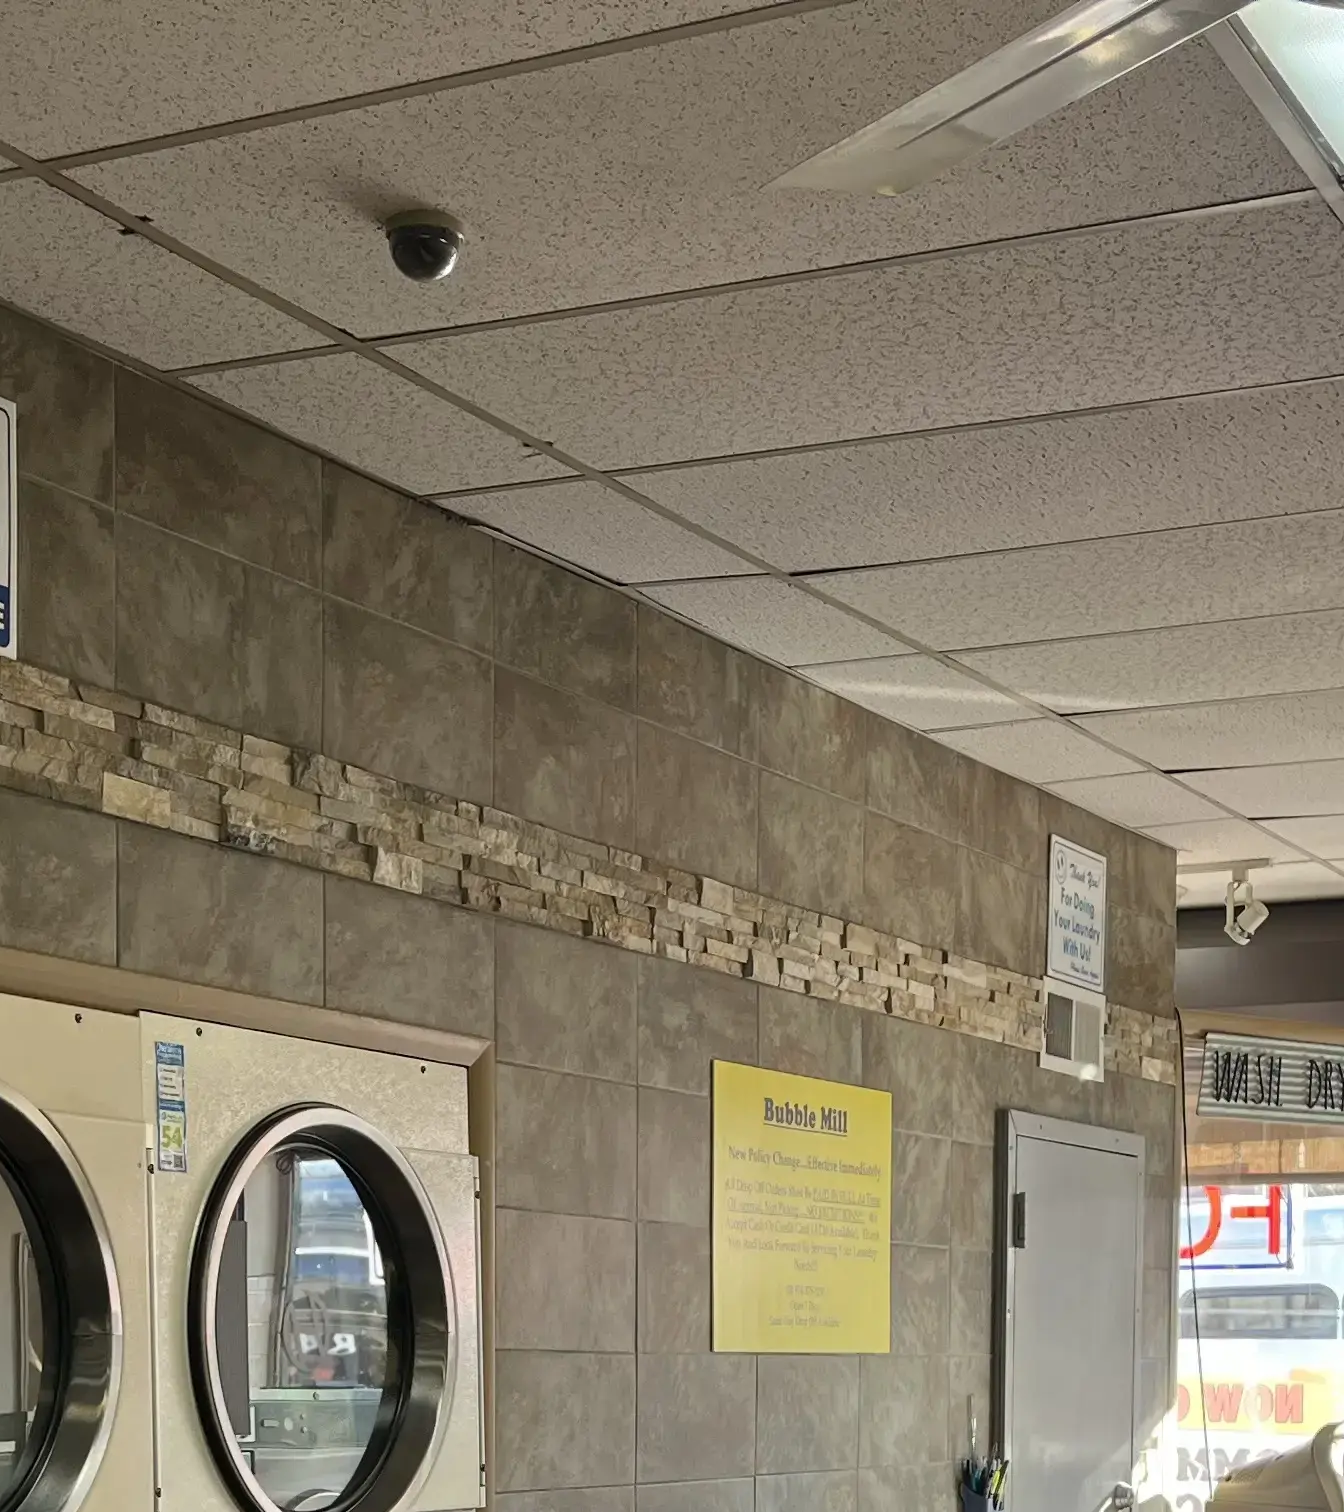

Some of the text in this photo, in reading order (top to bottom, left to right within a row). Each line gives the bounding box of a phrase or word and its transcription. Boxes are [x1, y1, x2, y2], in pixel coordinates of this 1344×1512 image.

[1060, 887, 1094, 919] For Doing
[1054, 910, 1100, 945] Your Laundry
[1063, 937, 1091, 962] With Us!
[763, 1097, 847, 1134] Bubble Mill
[161, 1125, 183, 1148] 54
[728, 1146, 747, 1161] New
